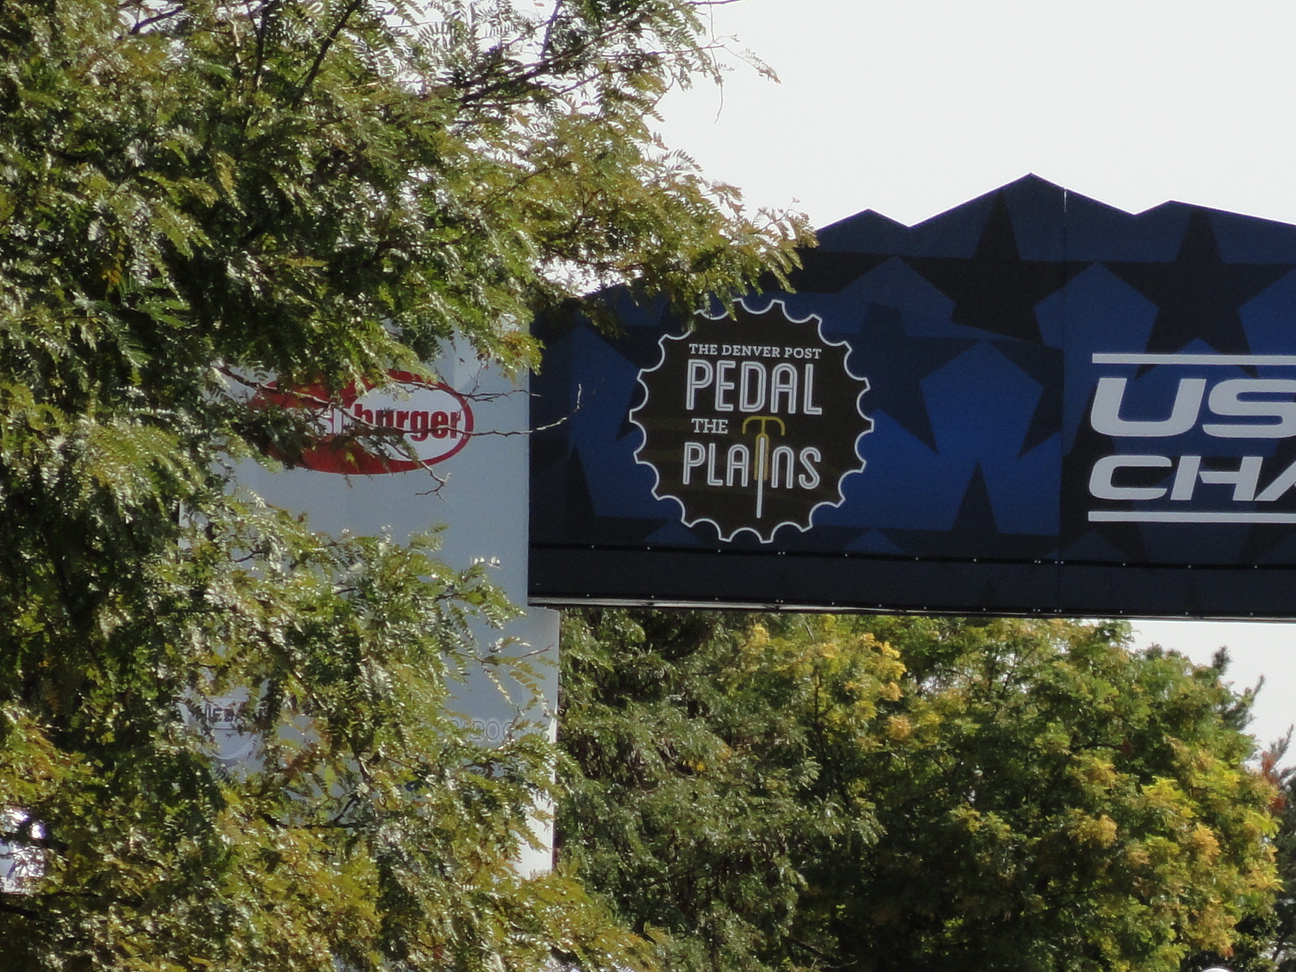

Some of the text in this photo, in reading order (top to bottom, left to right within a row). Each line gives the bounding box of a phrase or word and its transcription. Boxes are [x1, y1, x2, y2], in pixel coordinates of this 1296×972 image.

[688, 343, 822, 360] THE DENVER POST
[685, 358, 823, 416] PEDAL
[691, 417, 729, 434] THE
[682, 441, 822, 503] PLAINS
